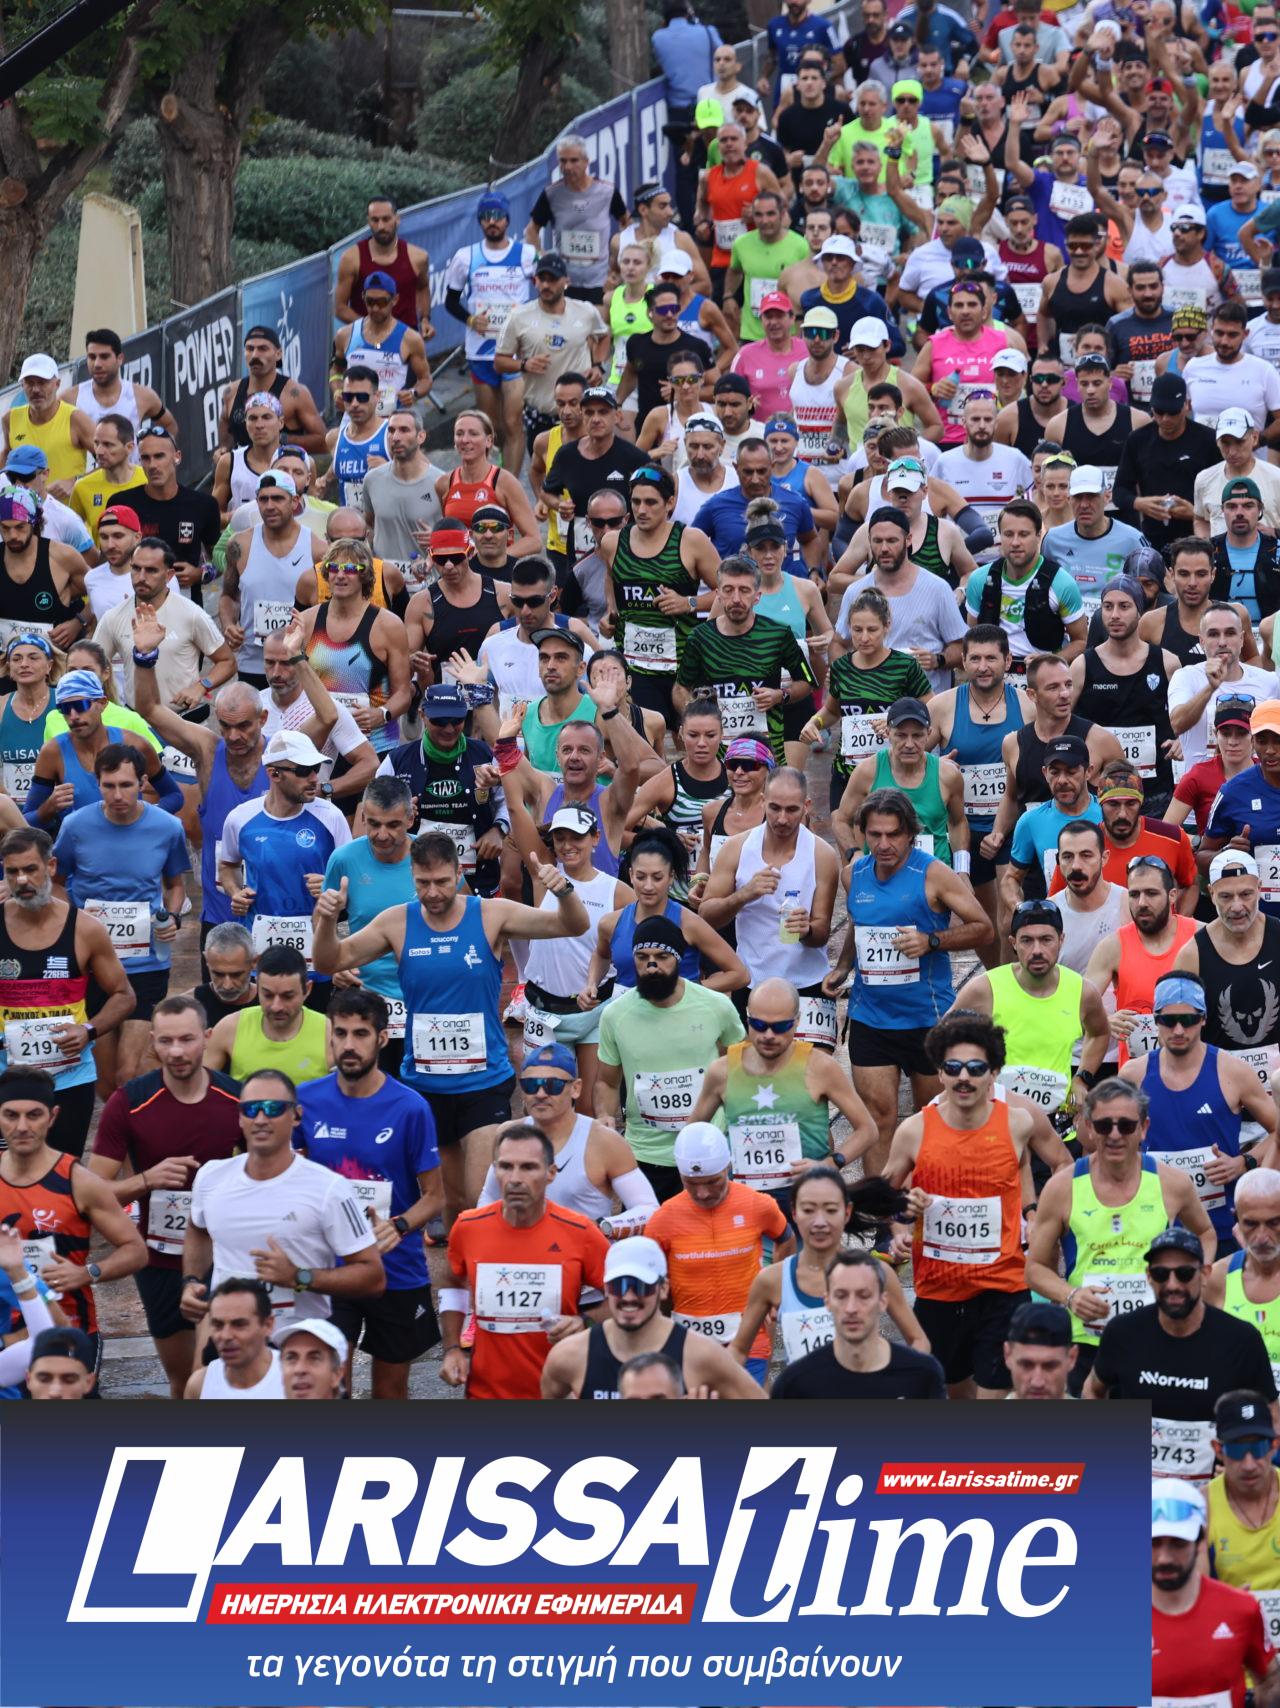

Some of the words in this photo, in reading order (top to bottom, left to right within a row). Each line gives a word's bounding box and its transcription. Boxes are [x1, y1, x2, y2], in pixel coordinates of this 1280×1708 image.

[174, 316, 235, 402] POWER
[338, 460, 366, 476] HELL
[634, 643, 664, 655] 2076
[722, 714, 755, 727] 2372
[971, 782, 1004, 797] 1219
[108, 924, 135, 938] 720
[266, 937, 305, 952] 1368
[866, 948, 901, 962] 2177
[428, 1037, 469, 1051] 1113
[650, 1094, 692, 1109] 1989
[743, 1149, 784, 1165] 1616
[935, 1221, 990, 1238] 16015
[495, 1291, 542, 1307] 1127
[1152, 1445, 1195, 1464] 9743
